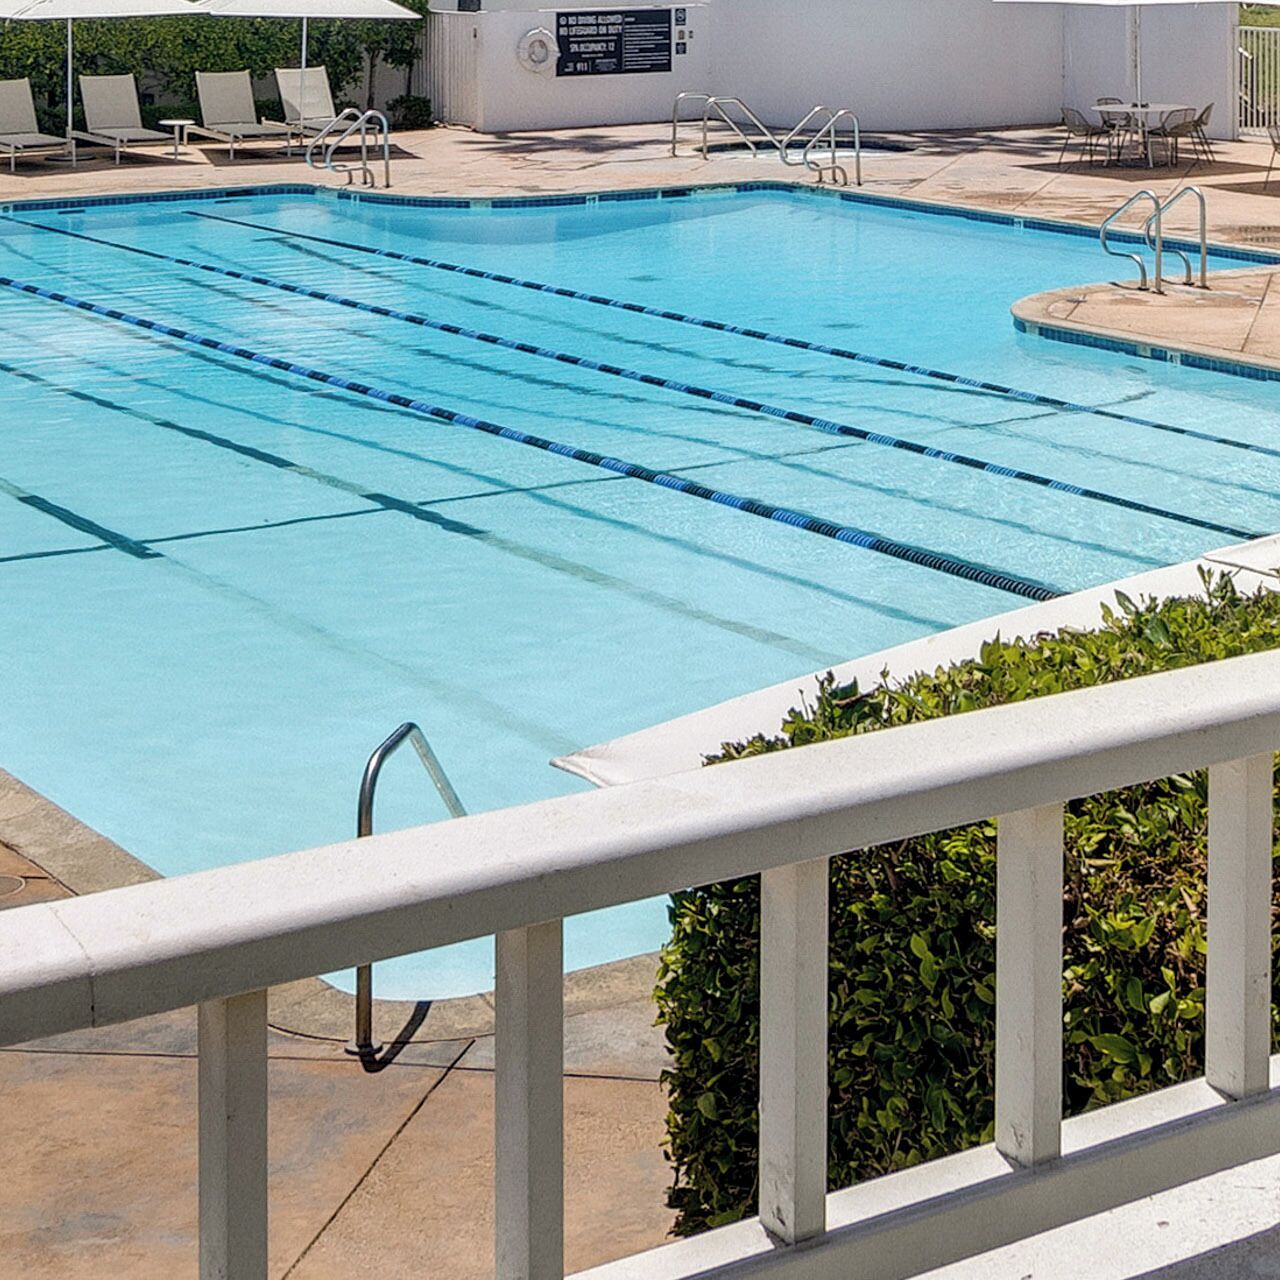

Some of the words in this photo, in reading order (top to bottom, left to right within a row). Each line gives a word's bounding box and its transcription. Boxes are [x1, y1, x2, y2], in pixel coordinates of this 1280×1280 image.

[568, 16, 576, 25] NO
[578, 15, 596, 24] DIVING
[559, 26, 568, 35] NO
[569, 25, 597, 35] LIFEGUARD
[599, 25, 607, 34] ON
[608, 24, 622, 34] DUTY
[576, 62, 587, 71] 911
